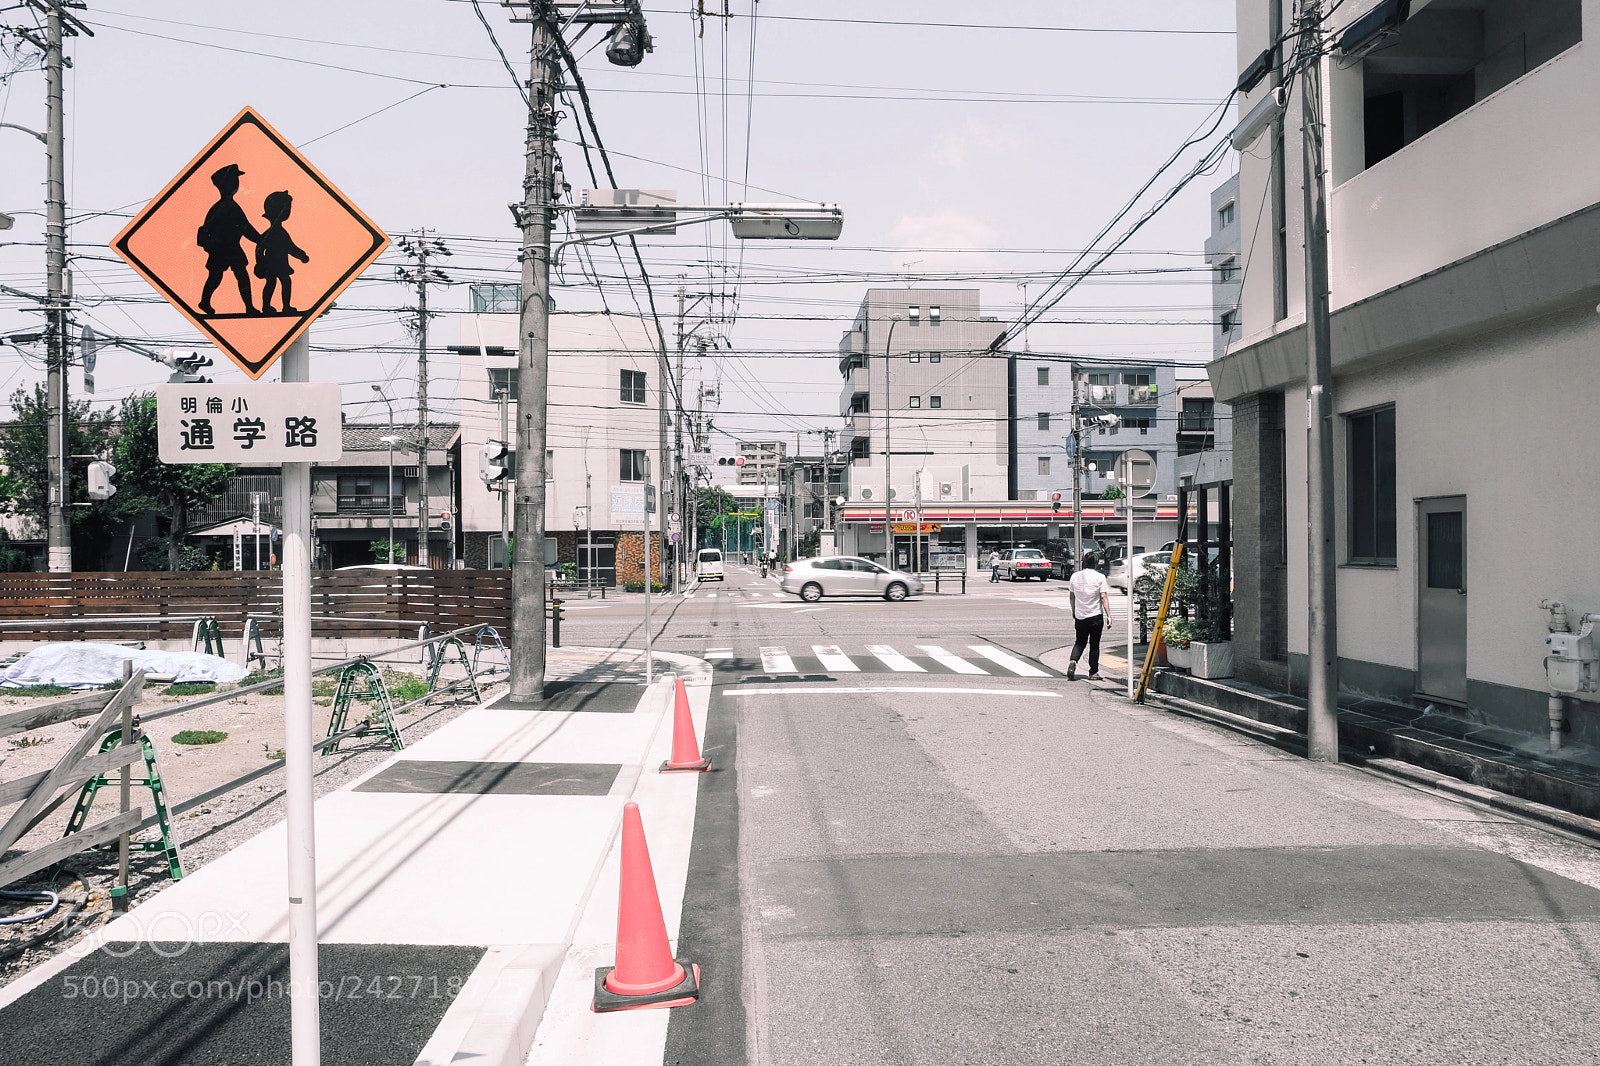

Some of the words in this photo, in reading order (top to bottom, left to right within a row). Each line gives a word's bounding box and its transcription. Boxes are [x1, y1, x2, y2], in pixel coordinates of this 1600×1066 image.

[181, 396, 248, 414] 明倫小
[180, 416, 318, 450] 通学路
